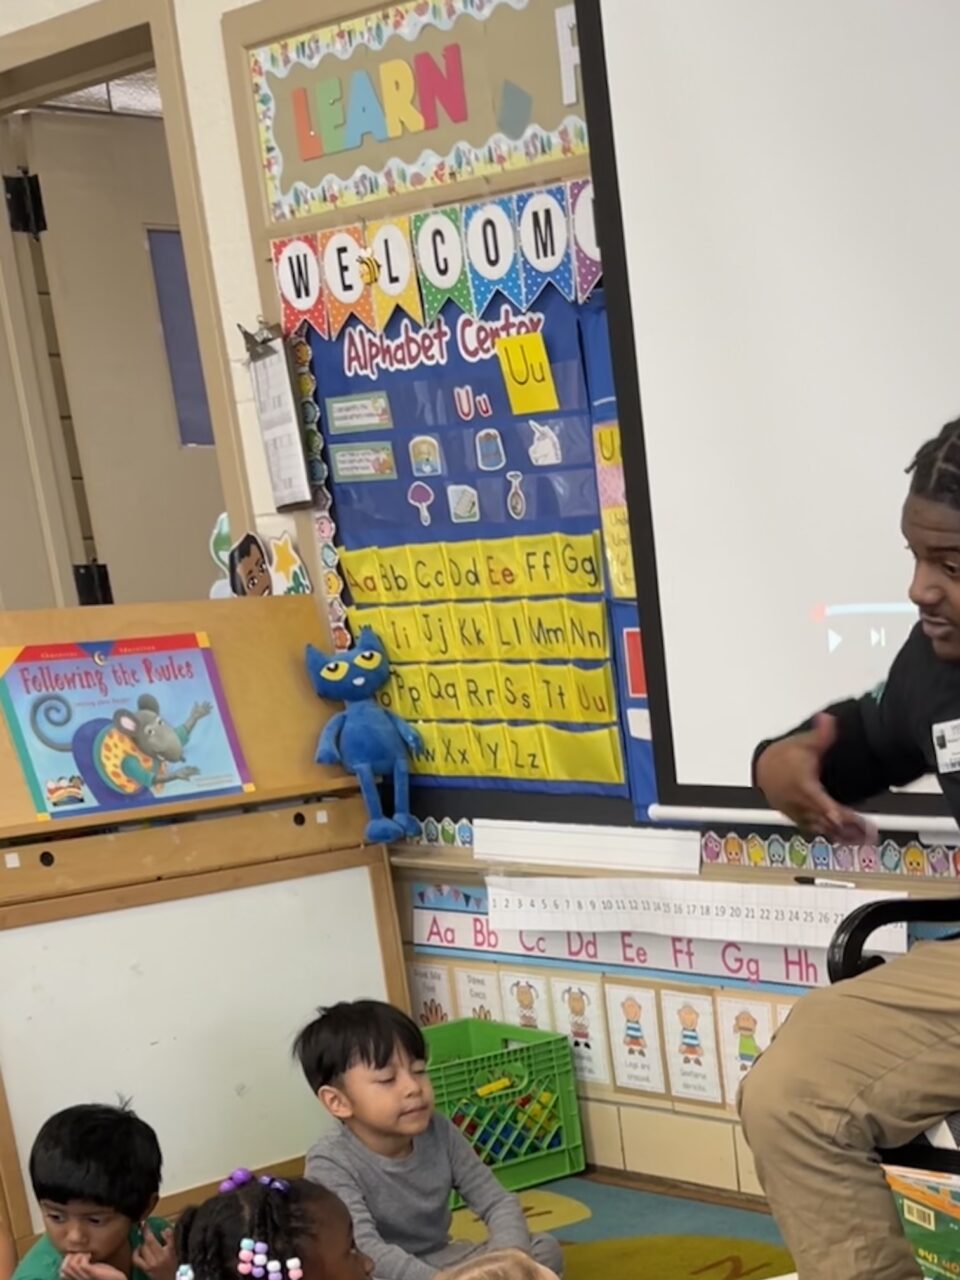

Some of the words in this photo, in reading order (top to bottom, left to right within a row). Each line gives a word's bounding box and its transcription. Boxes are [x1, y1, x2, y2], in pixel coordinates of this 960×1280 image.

[291, 43, 468, 162] LEARN
[289, 198, 598, 299] WELCOM
[346, 318, 449, 376] Alphabet
[504, 344, 546, 386] Uu
[455, 385, 491, 418] Uu
[414, 560, 444, 589] Cc
[450, 550, 479, 586] Dd
[487, 556, 515, 586] Ee
[526, 551, 551, 580] Ff
[562, 543, 598, 588] Gg
[422, 613, 449, 654] Jj
[459, 620, 484, 647] Kk
[570, 617, 601, 647] Nn
[20, 664, 109, 697] Following
[112, 661, 140, 688] the
[142, 656, 195, 684] Rules
[427, 672, 459, 703] Qq
[467, 678, 495, 707] Rr
[504, 678, 530, 710] Ss
[542, 679, 565, 710] Tt
[578, 690, 606, 713] Uu
[443, 738, 469, 765] Xx
[476, 731, 499, 760] Yy
[512, 741, 539, 770] Zz
[602, 900, 613, 911] 10
[615, 901, 626, 911] 11
[628, 901, 639, 911] 12
[673, 904, 683, 914] 16
[686, 904, 696, 915] 17
[700, 905, 710, 915] 18
[715, 906, 726, 916] 19
[730, 906, 742, 917] 20
[745, 908, 755, 918] 21
[759, 908, 770, 920] 22
[774, 909, 785, 921] 23
[789, 910, 800, 921] 24
[803, 911, 814, 922] 25
[818, 911, 830, 923] 26
[427, 916, 456, 944] Aa
[472, 917, 499, 948] Bb
[567, 930, 598, 959] Dd
[621, 931, 648, 964] Ee
[671, 937, 694, 969] Ff
[721, 941, 760, 984] Gg
[784, 946, 817, 983] Hh
